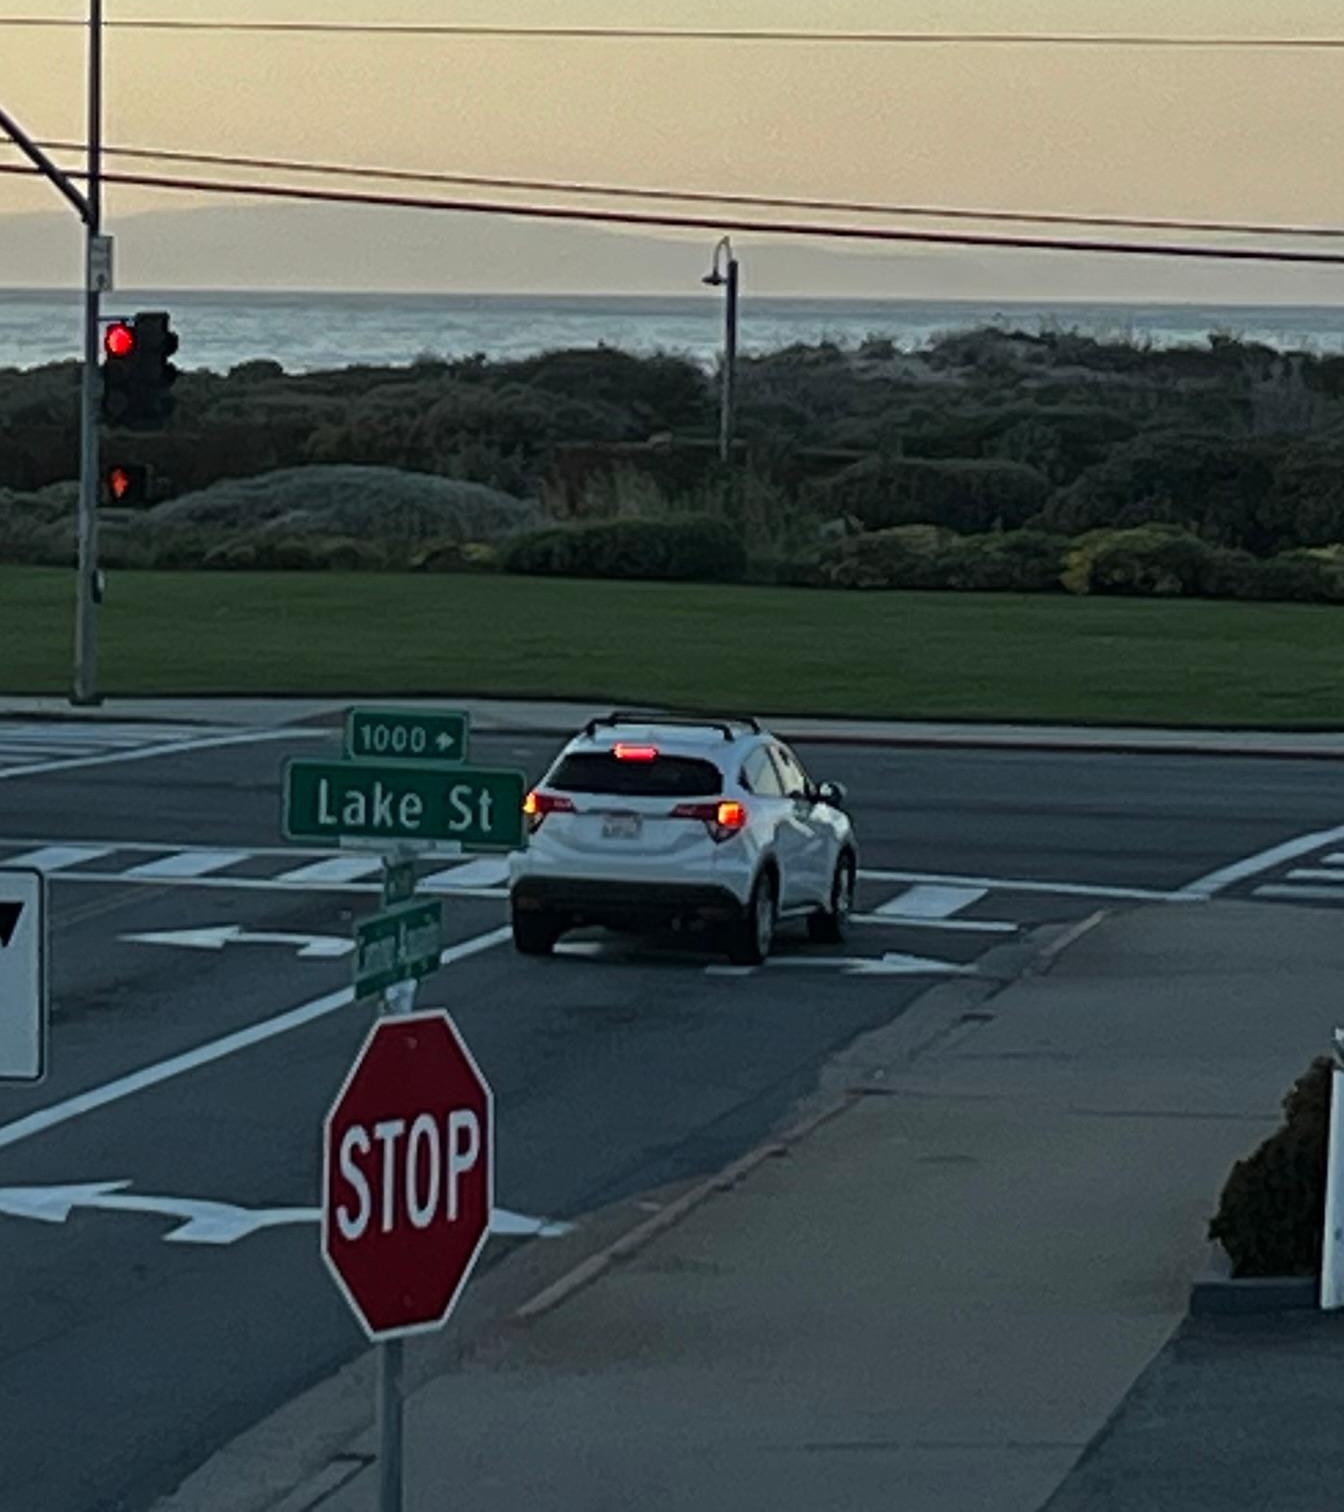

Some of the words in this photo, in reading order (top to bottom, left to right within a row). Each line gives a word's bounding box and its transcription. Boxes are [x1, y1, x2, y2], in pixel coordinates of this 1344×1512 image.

[360, 724, 427, 752] 1000
[318, 779, 424, 829] Lake
[448, 785, 492, 832] St
[336, 1108, 481, 1240] STOP
